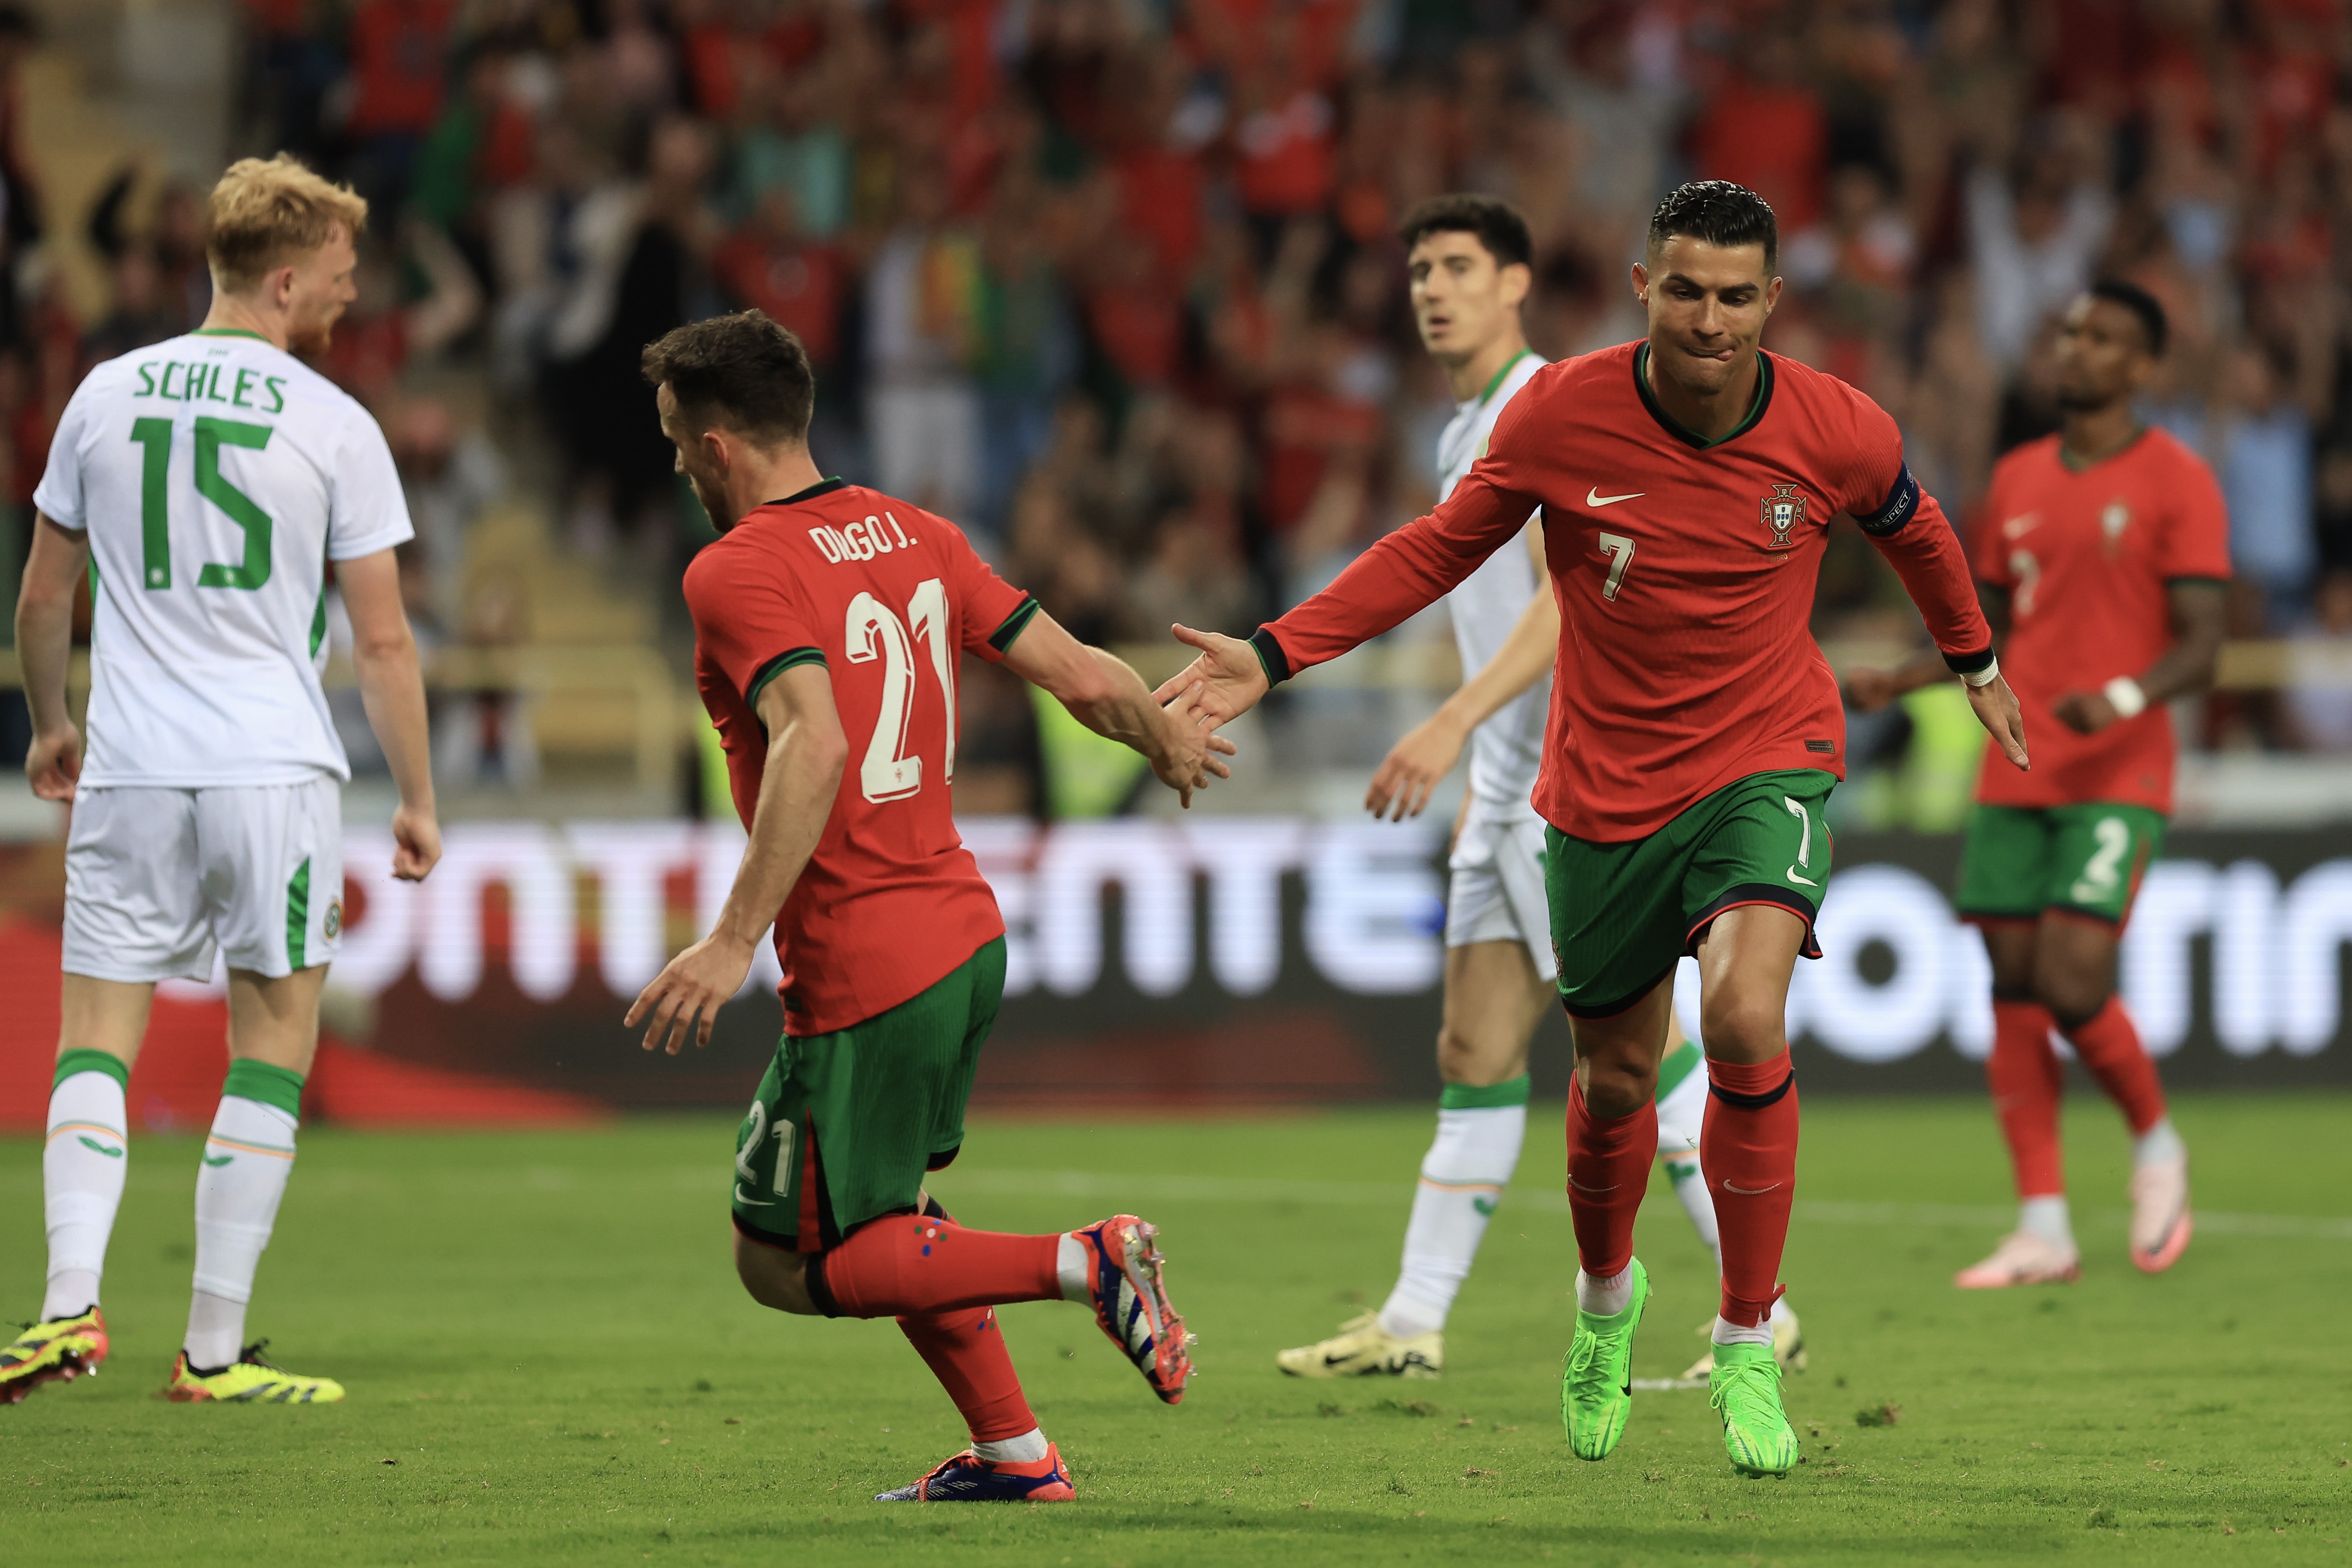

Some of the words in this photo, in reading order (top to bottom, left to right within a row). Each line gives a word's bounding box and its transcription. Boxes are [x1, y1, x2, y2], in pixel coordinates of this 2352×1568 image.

[133, 361, 287, 414] SCALES
[130, 417, 273, 590] 15
[884, 511, 918, 549] J.
[1866, 491, 1909, 528] RESPECT
[1599, 531, 1636, 602] 7
[845, 576, 956, 804] 21
[1784, 795, 1811, 869] 7
[2082, 815, 2130, 888] 2
[735, 1099, 796, 1198] 21
